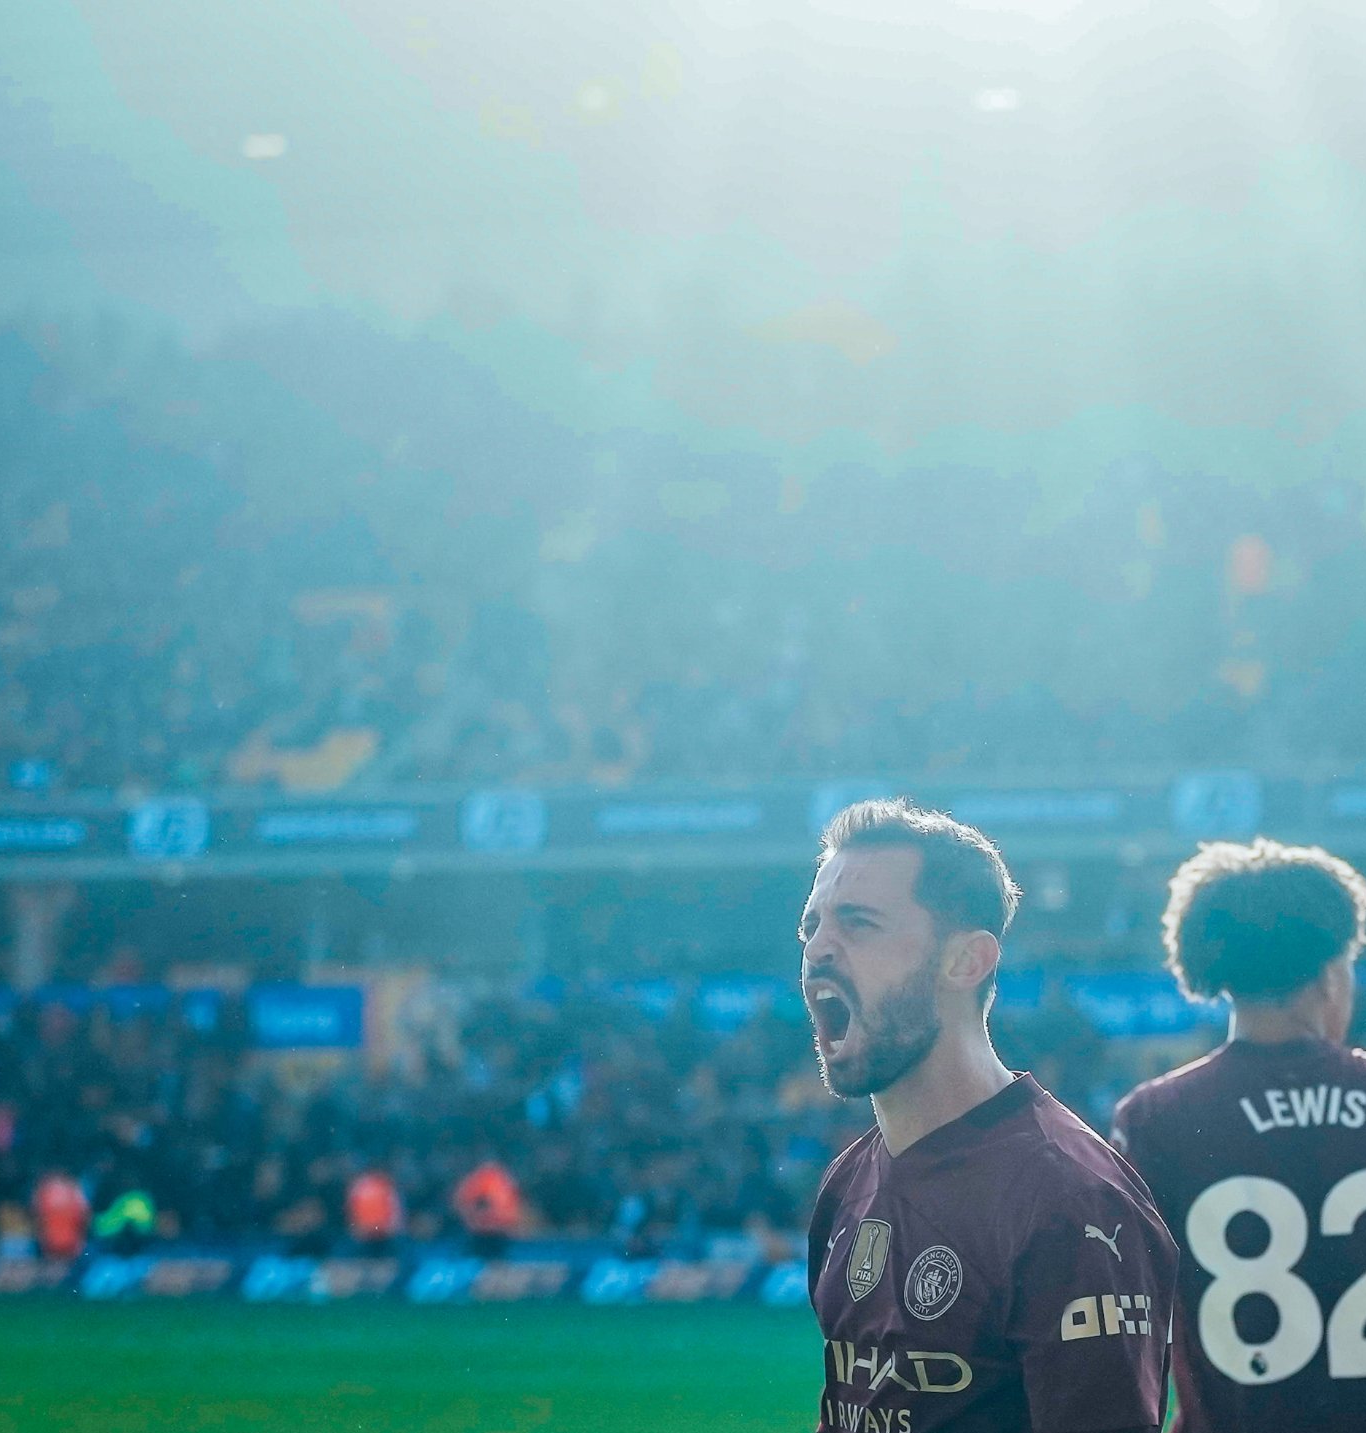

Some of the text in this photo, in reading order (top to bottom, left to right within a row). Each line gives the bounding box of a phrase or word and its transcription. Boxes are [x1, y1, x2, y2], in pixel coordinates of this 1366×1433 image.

[918, 1250, 958, 1283] MANCHESTER
[855, 1269, 872, 1282] FIFA
[914, 1303, 930, 1315] CITY
